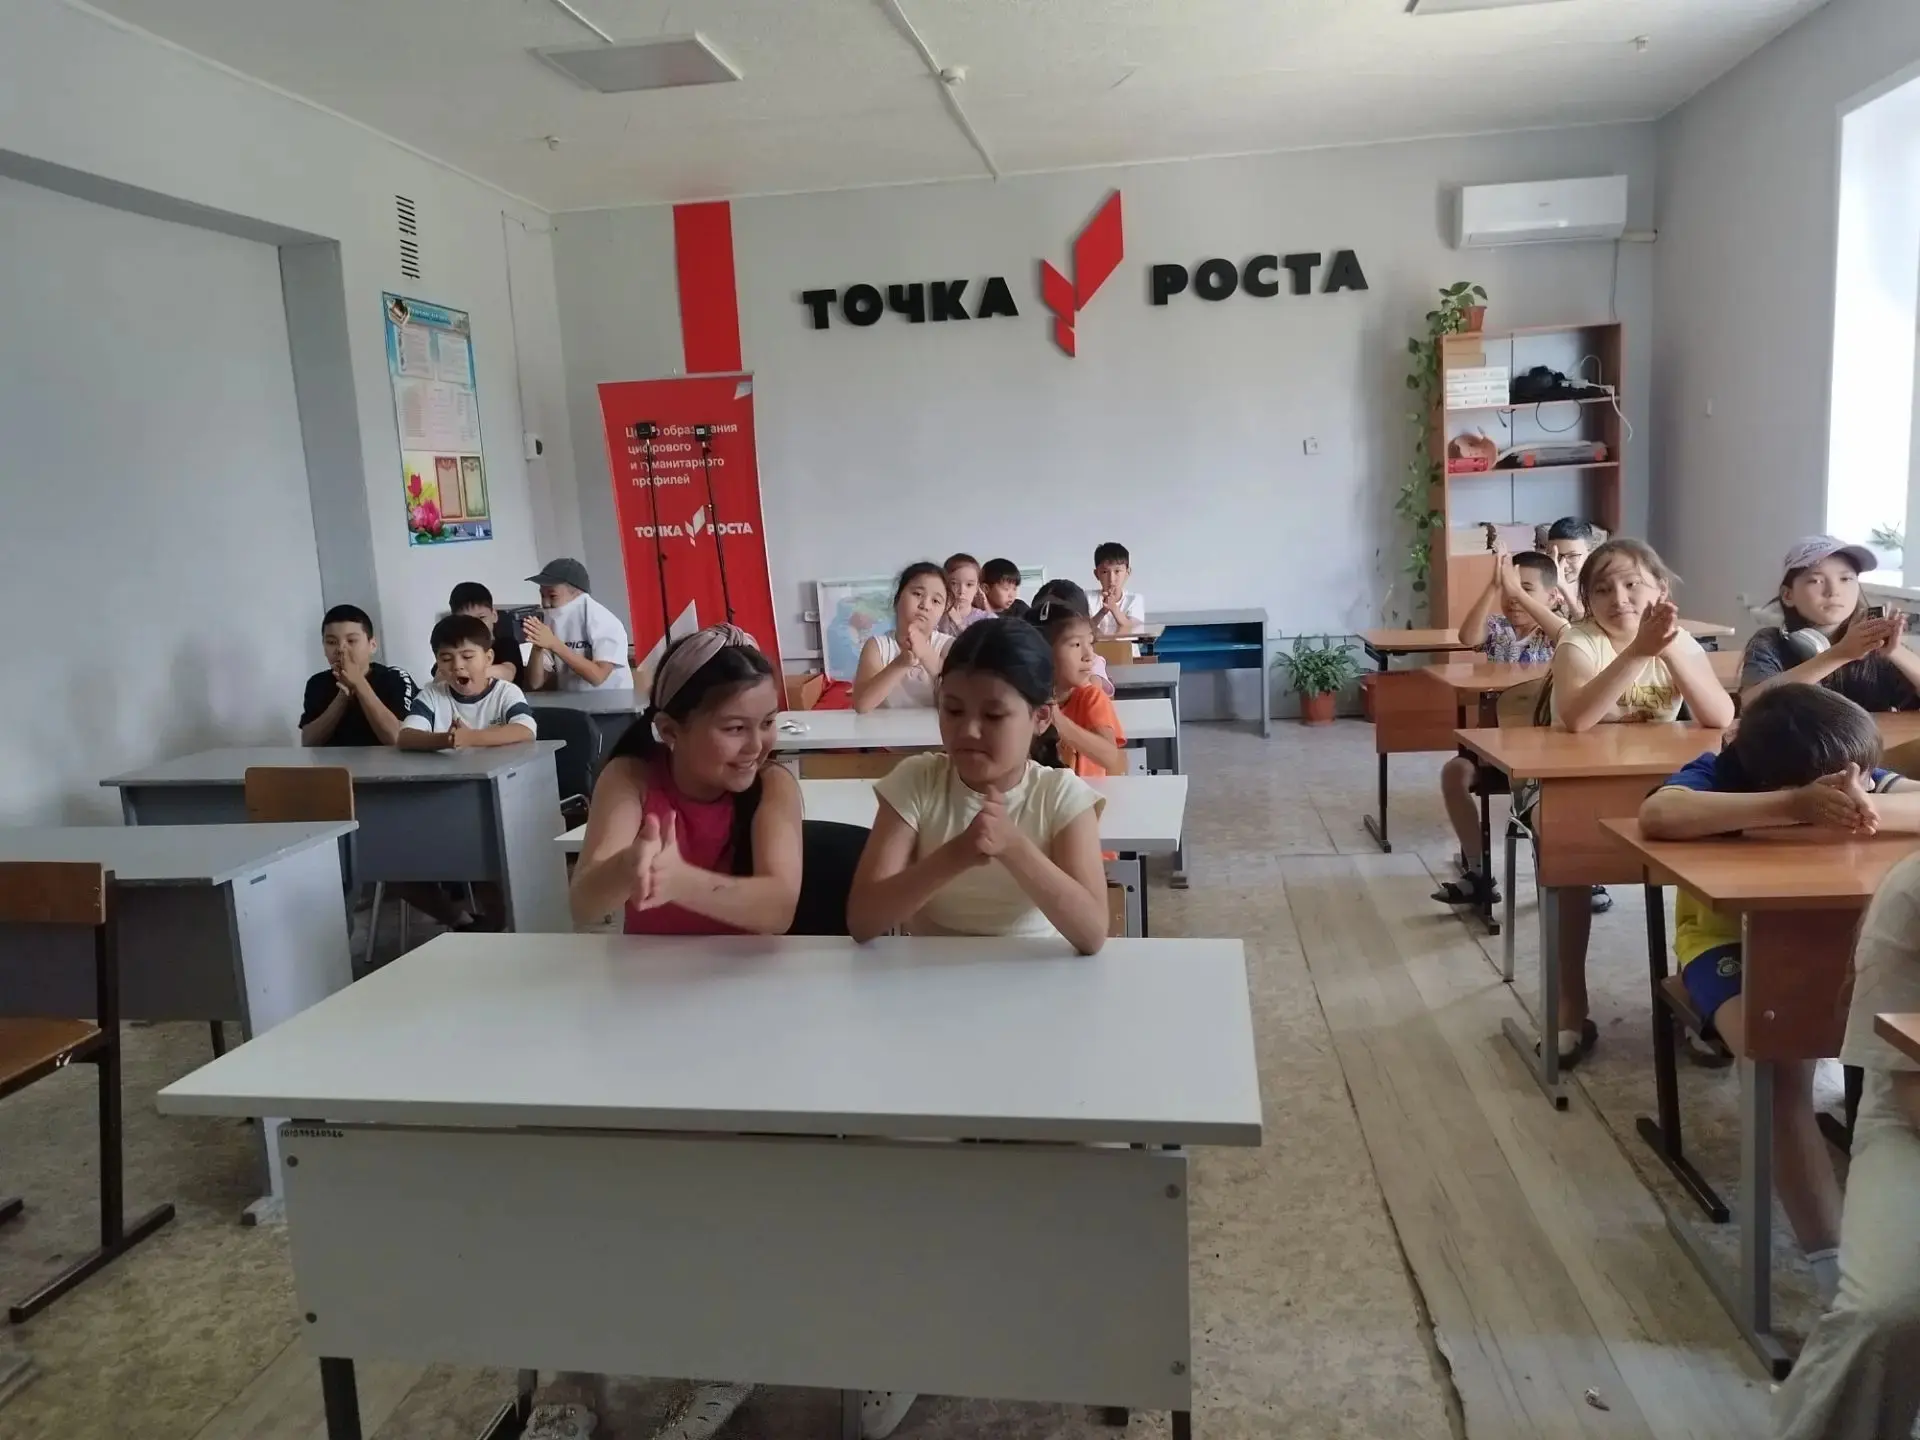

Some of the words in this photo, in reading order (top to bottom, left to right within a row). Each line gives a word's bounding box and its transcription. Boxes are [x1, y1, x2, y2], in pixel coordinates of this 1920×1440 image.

[803, 276, 1019, 329] ТОЧКА
[1152, 249, 1368, 306] РОСТА
[663, 424, 738, 437] образания
[630, 461, 638, 471] и
[706, 522, 754, 536] РОСТА
